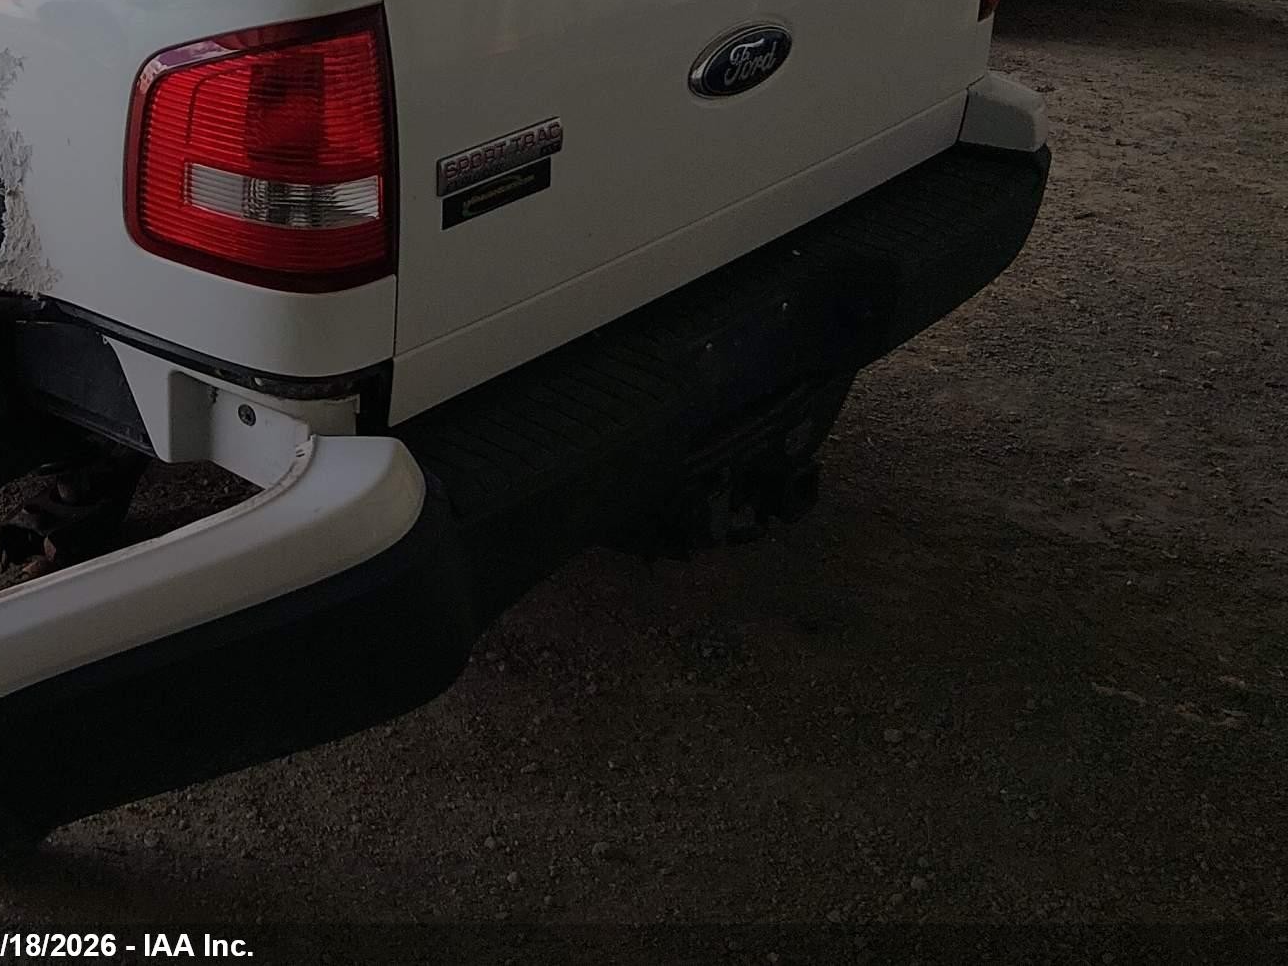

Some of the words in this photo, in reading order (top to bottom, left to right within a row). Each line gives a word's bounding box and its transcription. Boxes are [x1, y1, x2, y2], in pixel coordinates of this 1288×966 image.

[723, 37, 777, 86] Ford
[444, 142, 507, 180] SPORT
[509, 120, 562, 152] TRAC
